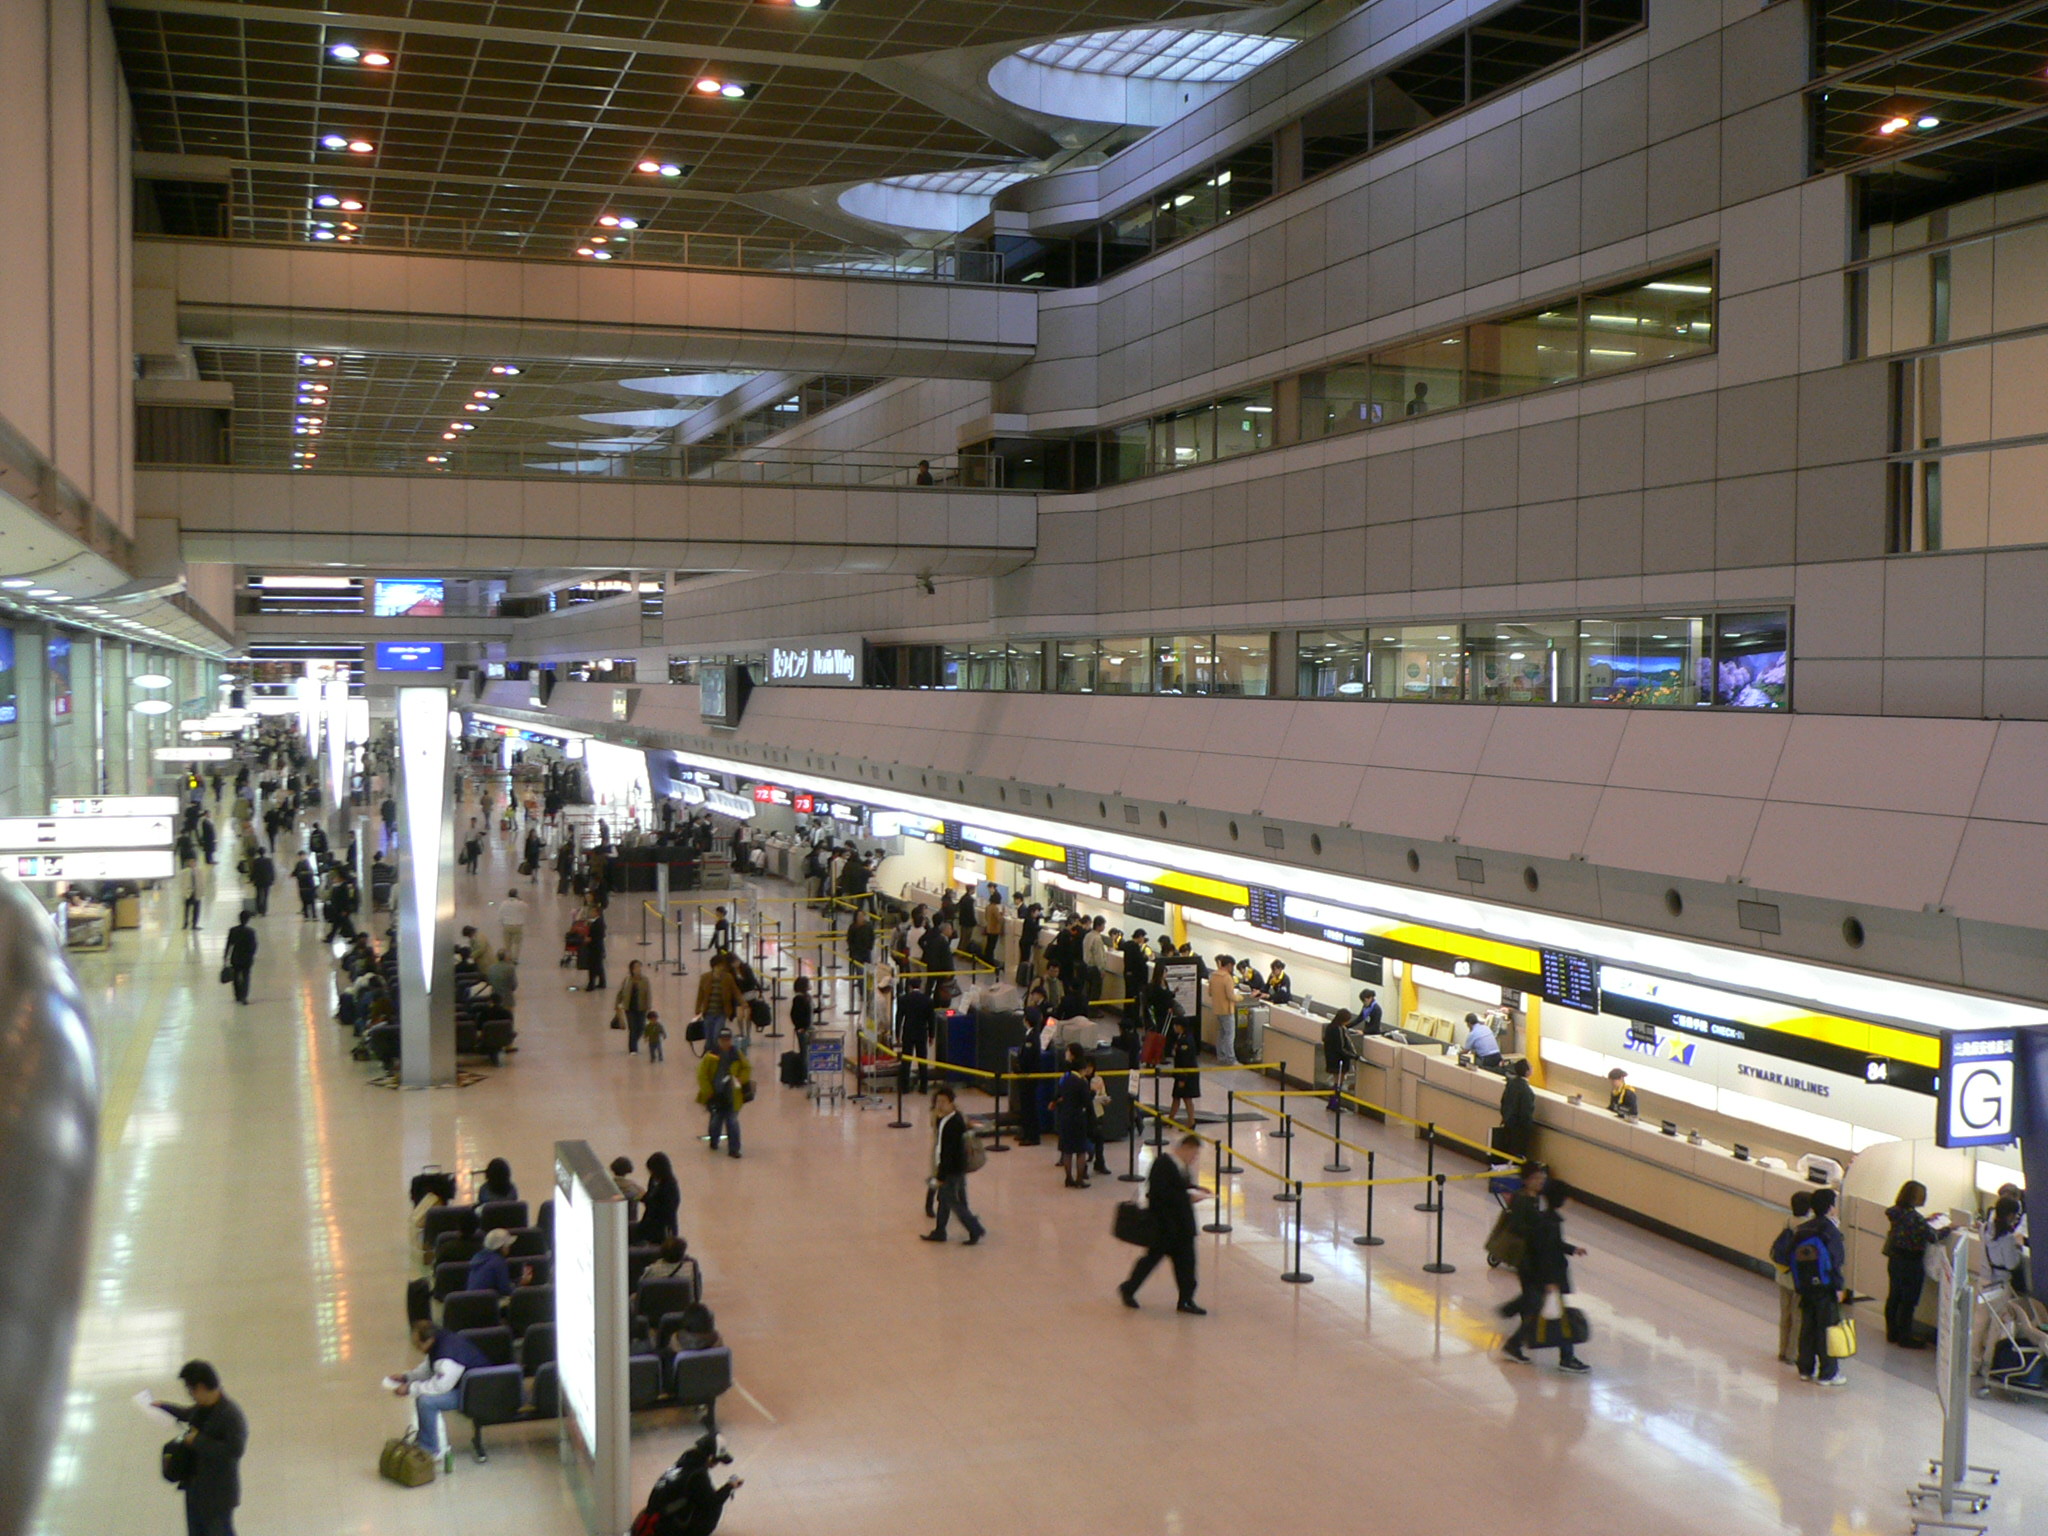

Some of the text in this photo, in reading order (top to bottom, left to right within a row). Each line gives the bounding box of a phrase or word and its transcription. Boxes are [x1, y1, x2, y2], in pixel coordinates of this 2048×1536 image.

[755, 789, 769, 799] 72
[815, 802, 829, 813] 74
[1738, 1063, 1830, 1097] SKYMARK AIRLINES
[1866, 1061, 1888, 1081] 84
[1960, 1068, 2002, 1130] G
